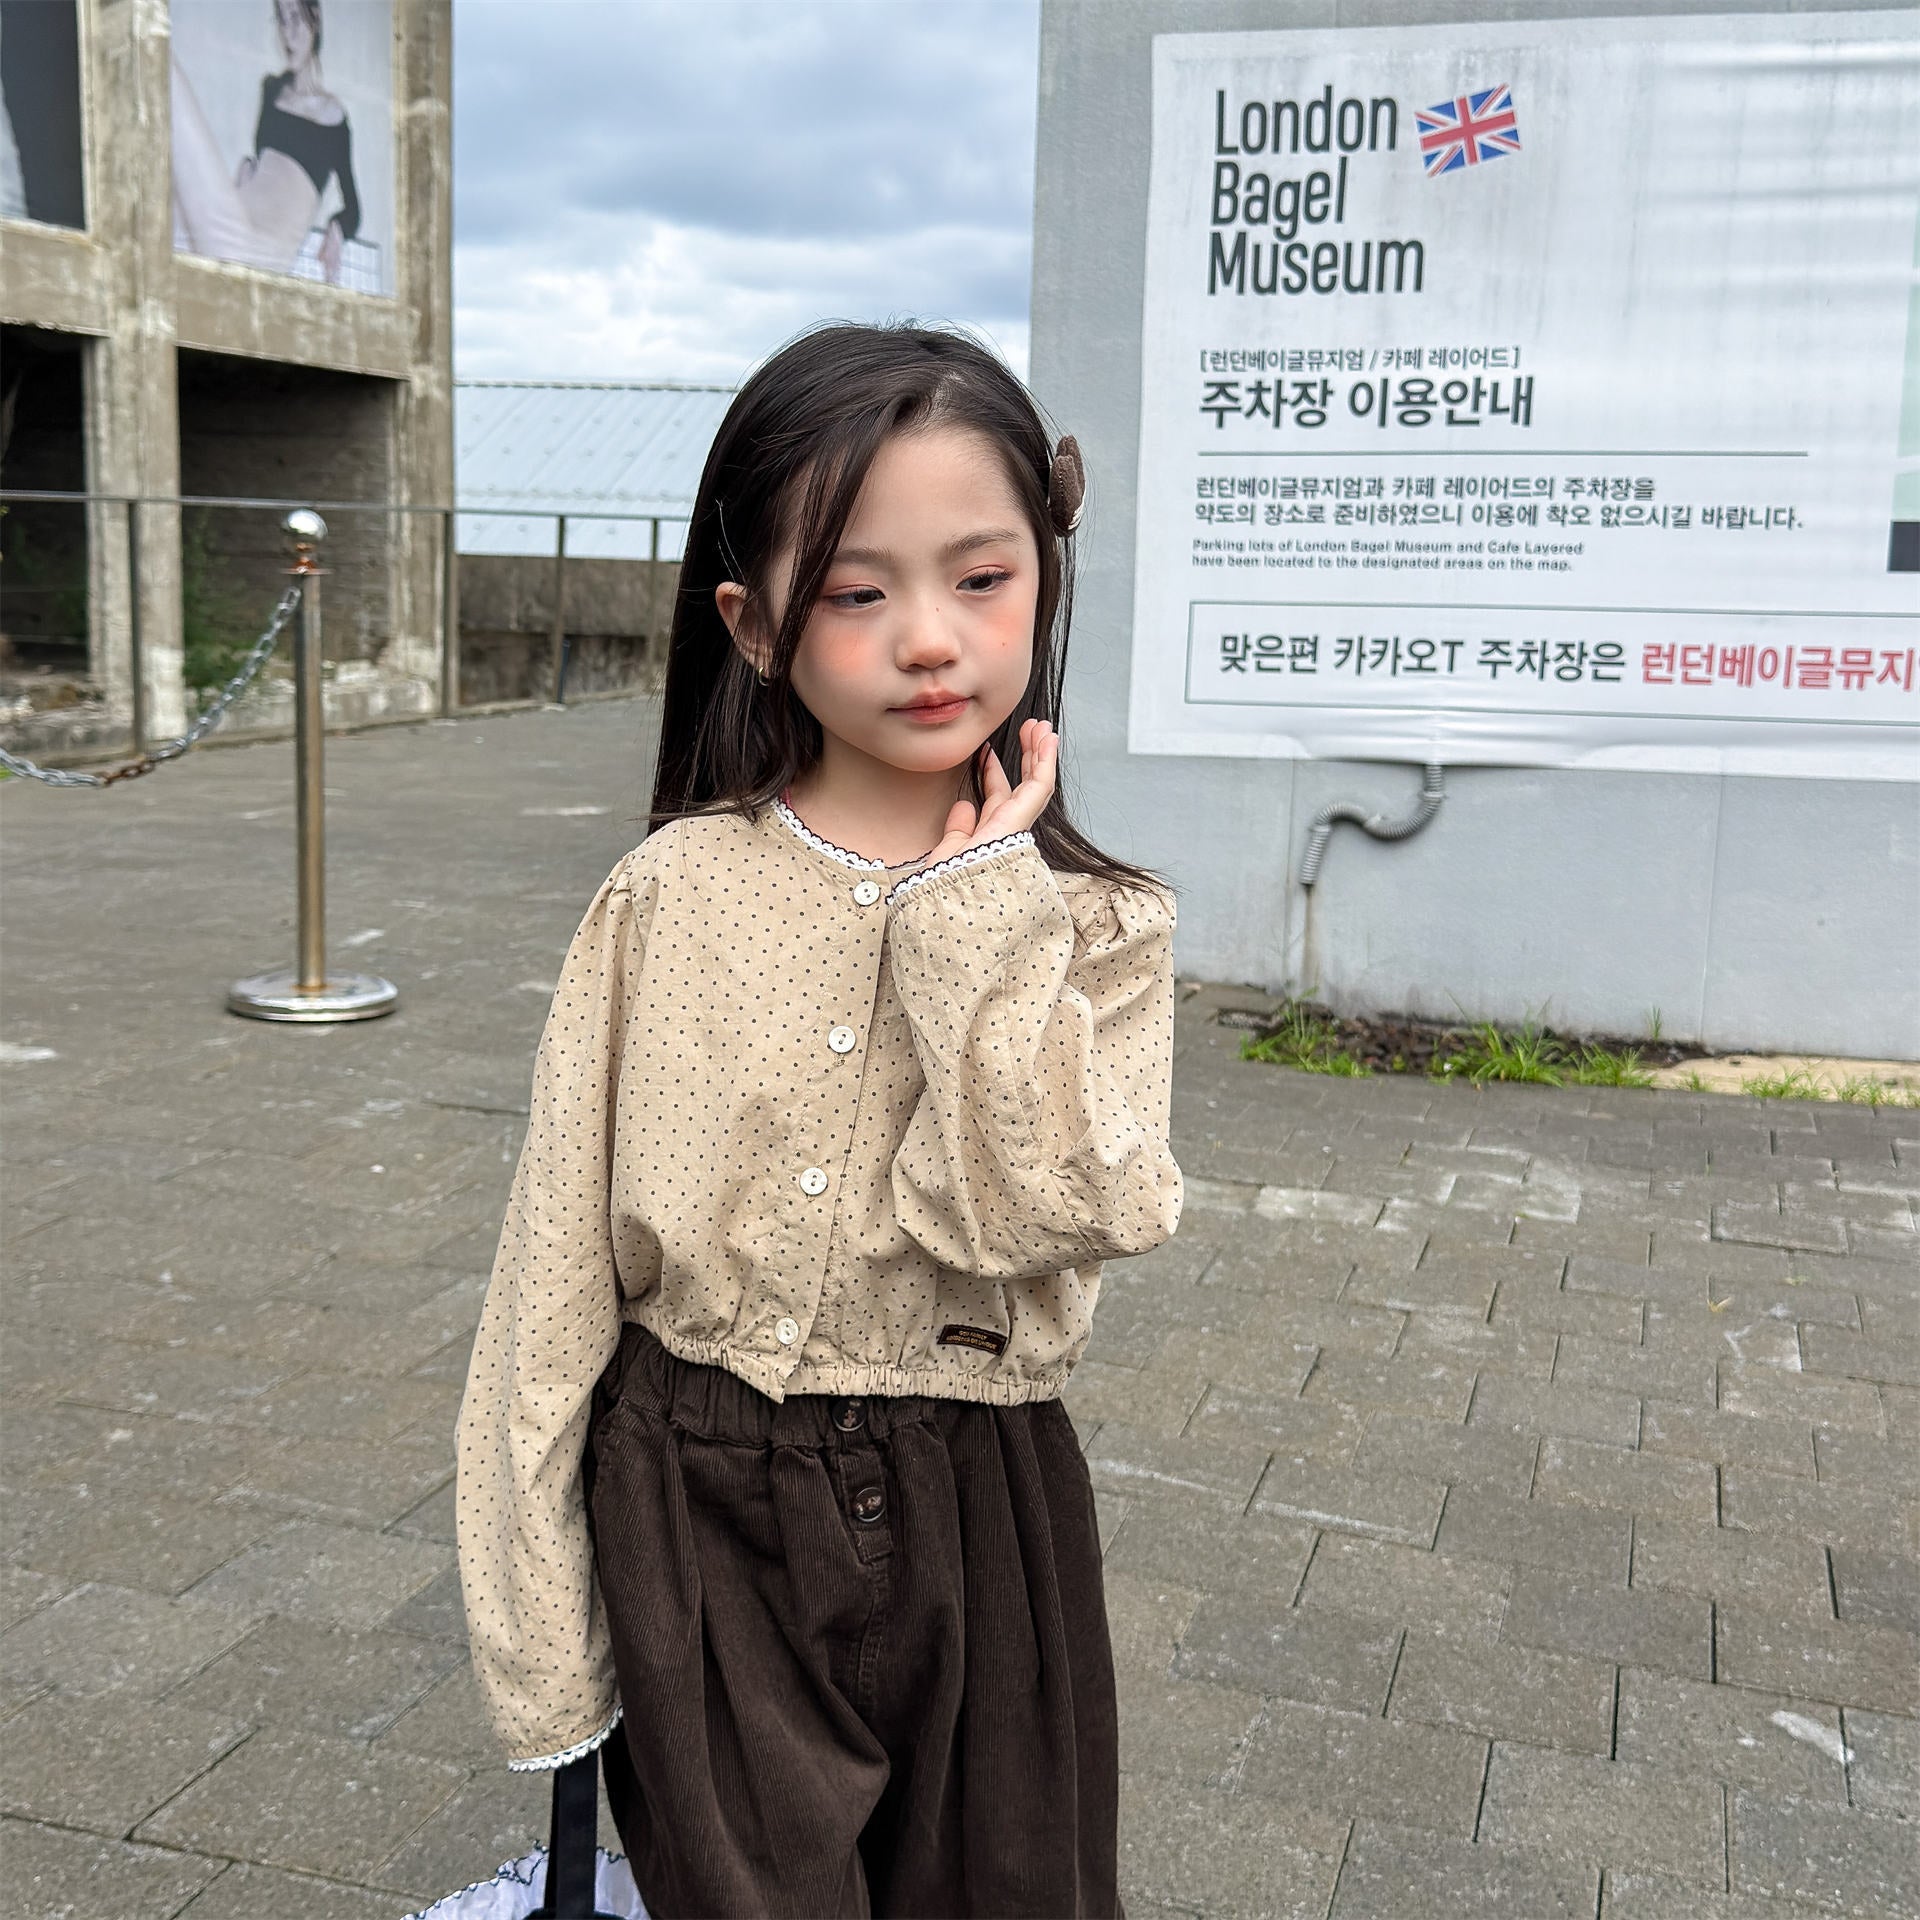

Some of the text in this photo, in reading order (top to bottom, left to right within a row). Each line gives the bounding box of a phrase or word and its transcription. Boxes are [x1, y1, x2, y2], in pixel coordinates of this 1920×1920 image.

[1215, 83, 1398, 155] London
[1212, 155, 1349, 241] Bagel
[1208, 230, 1424, 296] Museum
[1383, 347, 1424, 370] 카페
[1199, 375, 1534, 430] 주차장 이용안내
[1196, 476, 1656, 502] 런던베이글뮤지엄과 카페 레이어드의 주차장을
[1195, 503, 1803, 531] 약도의 장소로 준비하였으니 이용에 착오 없으시길 바랍니다.
[1192, 539, 1583, 555] Parking lots of London Bagel Museum and Cafe Layered
[1192, 555, 1571, 572] have been located to the designated areas on the map.
[1220, 633, 1920, 692] 맞은편 카카오T 주차장은 런던베이글뮤지
